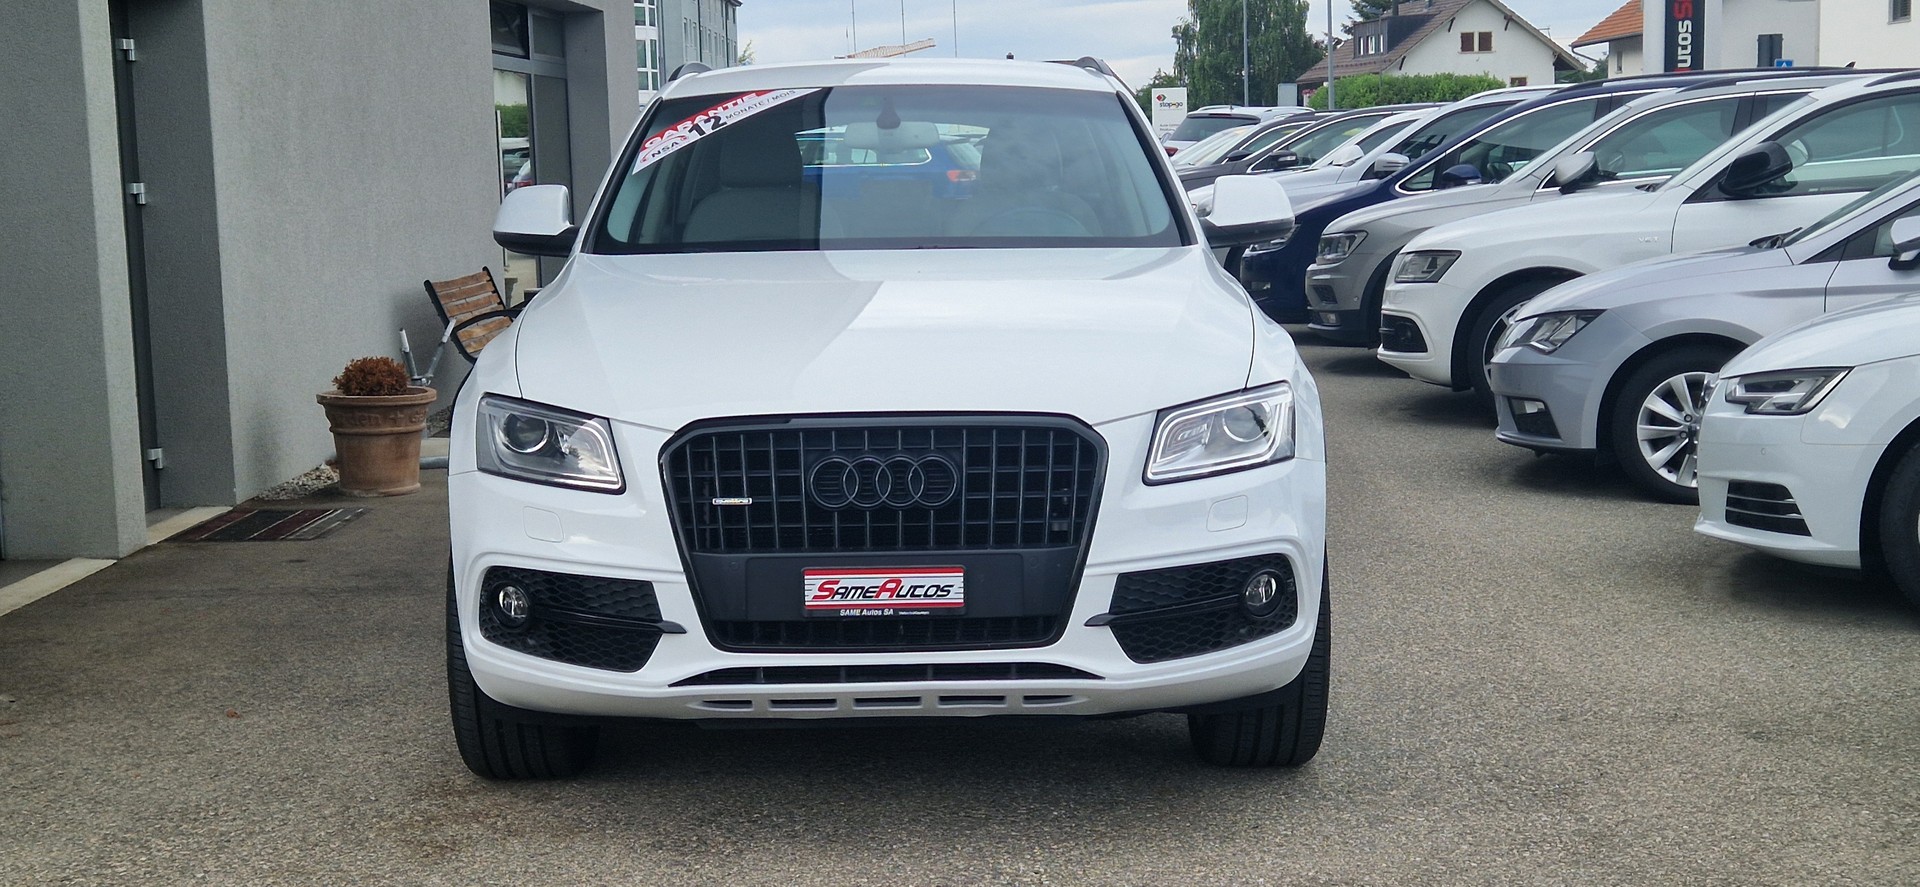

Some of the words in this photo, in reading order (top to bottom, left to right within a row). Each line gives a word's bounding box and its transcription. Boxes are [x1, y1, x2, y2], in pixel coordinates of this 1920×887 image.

[687, 115, 728, 137] 12
[725, 101, 764, 120] MONATE
[772, 89, 797, 101] MOIS
[651, 141, 681, 158] NSA
[862, 608, 883, 616] Autos
[883, 608, 894, 616] SA
